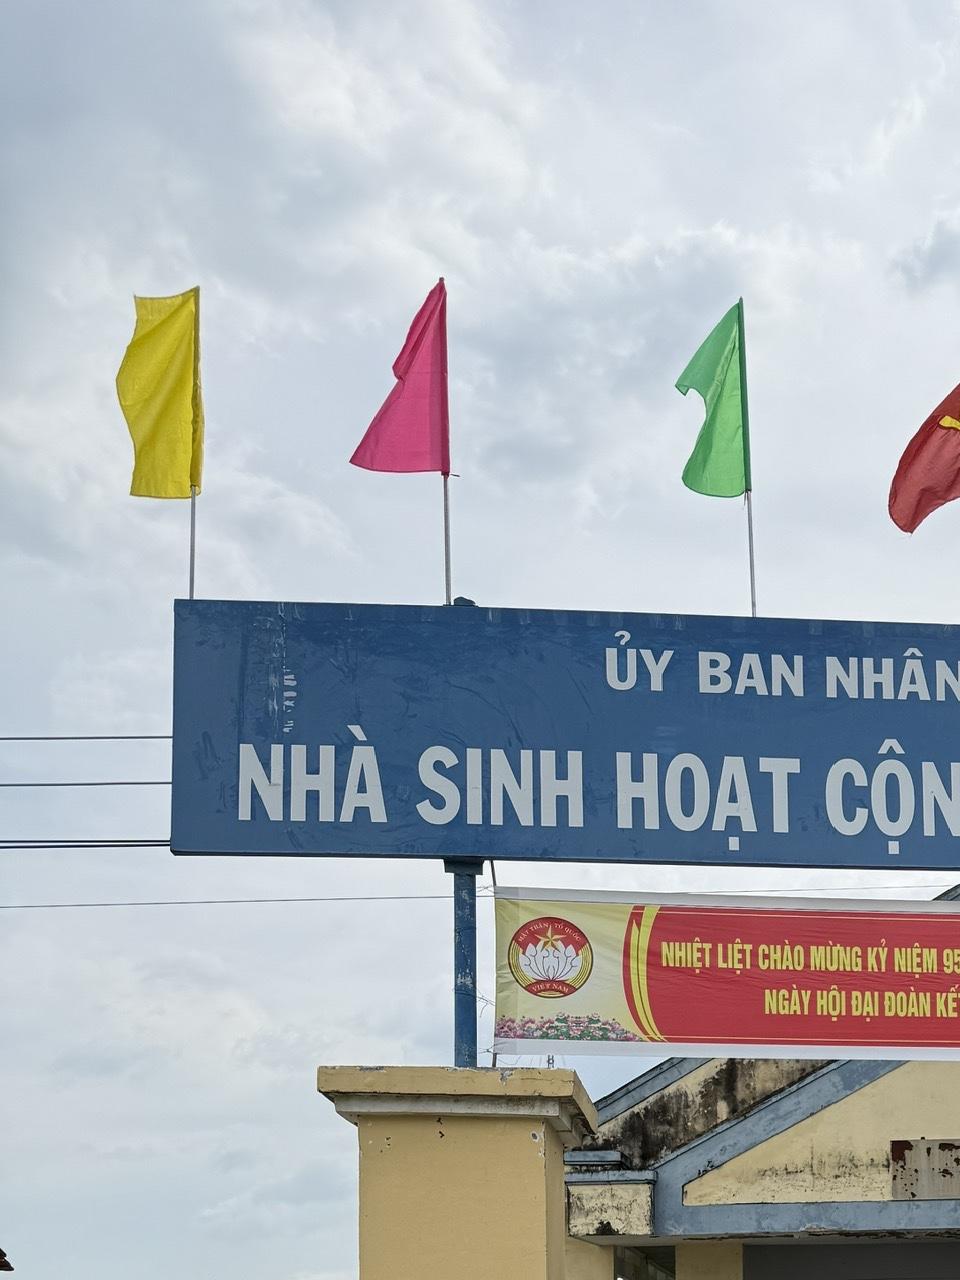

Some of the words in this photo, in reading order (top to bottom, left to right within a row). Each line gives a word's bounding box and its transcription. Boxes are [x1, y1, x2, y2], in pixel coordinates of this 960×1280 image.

[606, 631, 673, 691] ỦY
[699, 652, 803, 696] BAN
[239, 725, 387, 822] NHÀ
[416, 746, 583, 827] SINH
[616, 752, 800, 850] HOẠT
[661, 939, 712, 973] NHIỆT
[718, 938, 752, 972] LIỆT
[758, 940, 804, 970] CHÀO
[810, 941, 862, 971] MỪNG
[868, 939, 888, 972] KỶ
[894, 943, 937, 978] NIỆM
[765, 985, 811, 1015] NGÀY
[817, 988, 846, 1021] HỘI
[851, 991, 879, 1021] ĐẠI
[884, 987, 930, 1017] ĐOÀN
